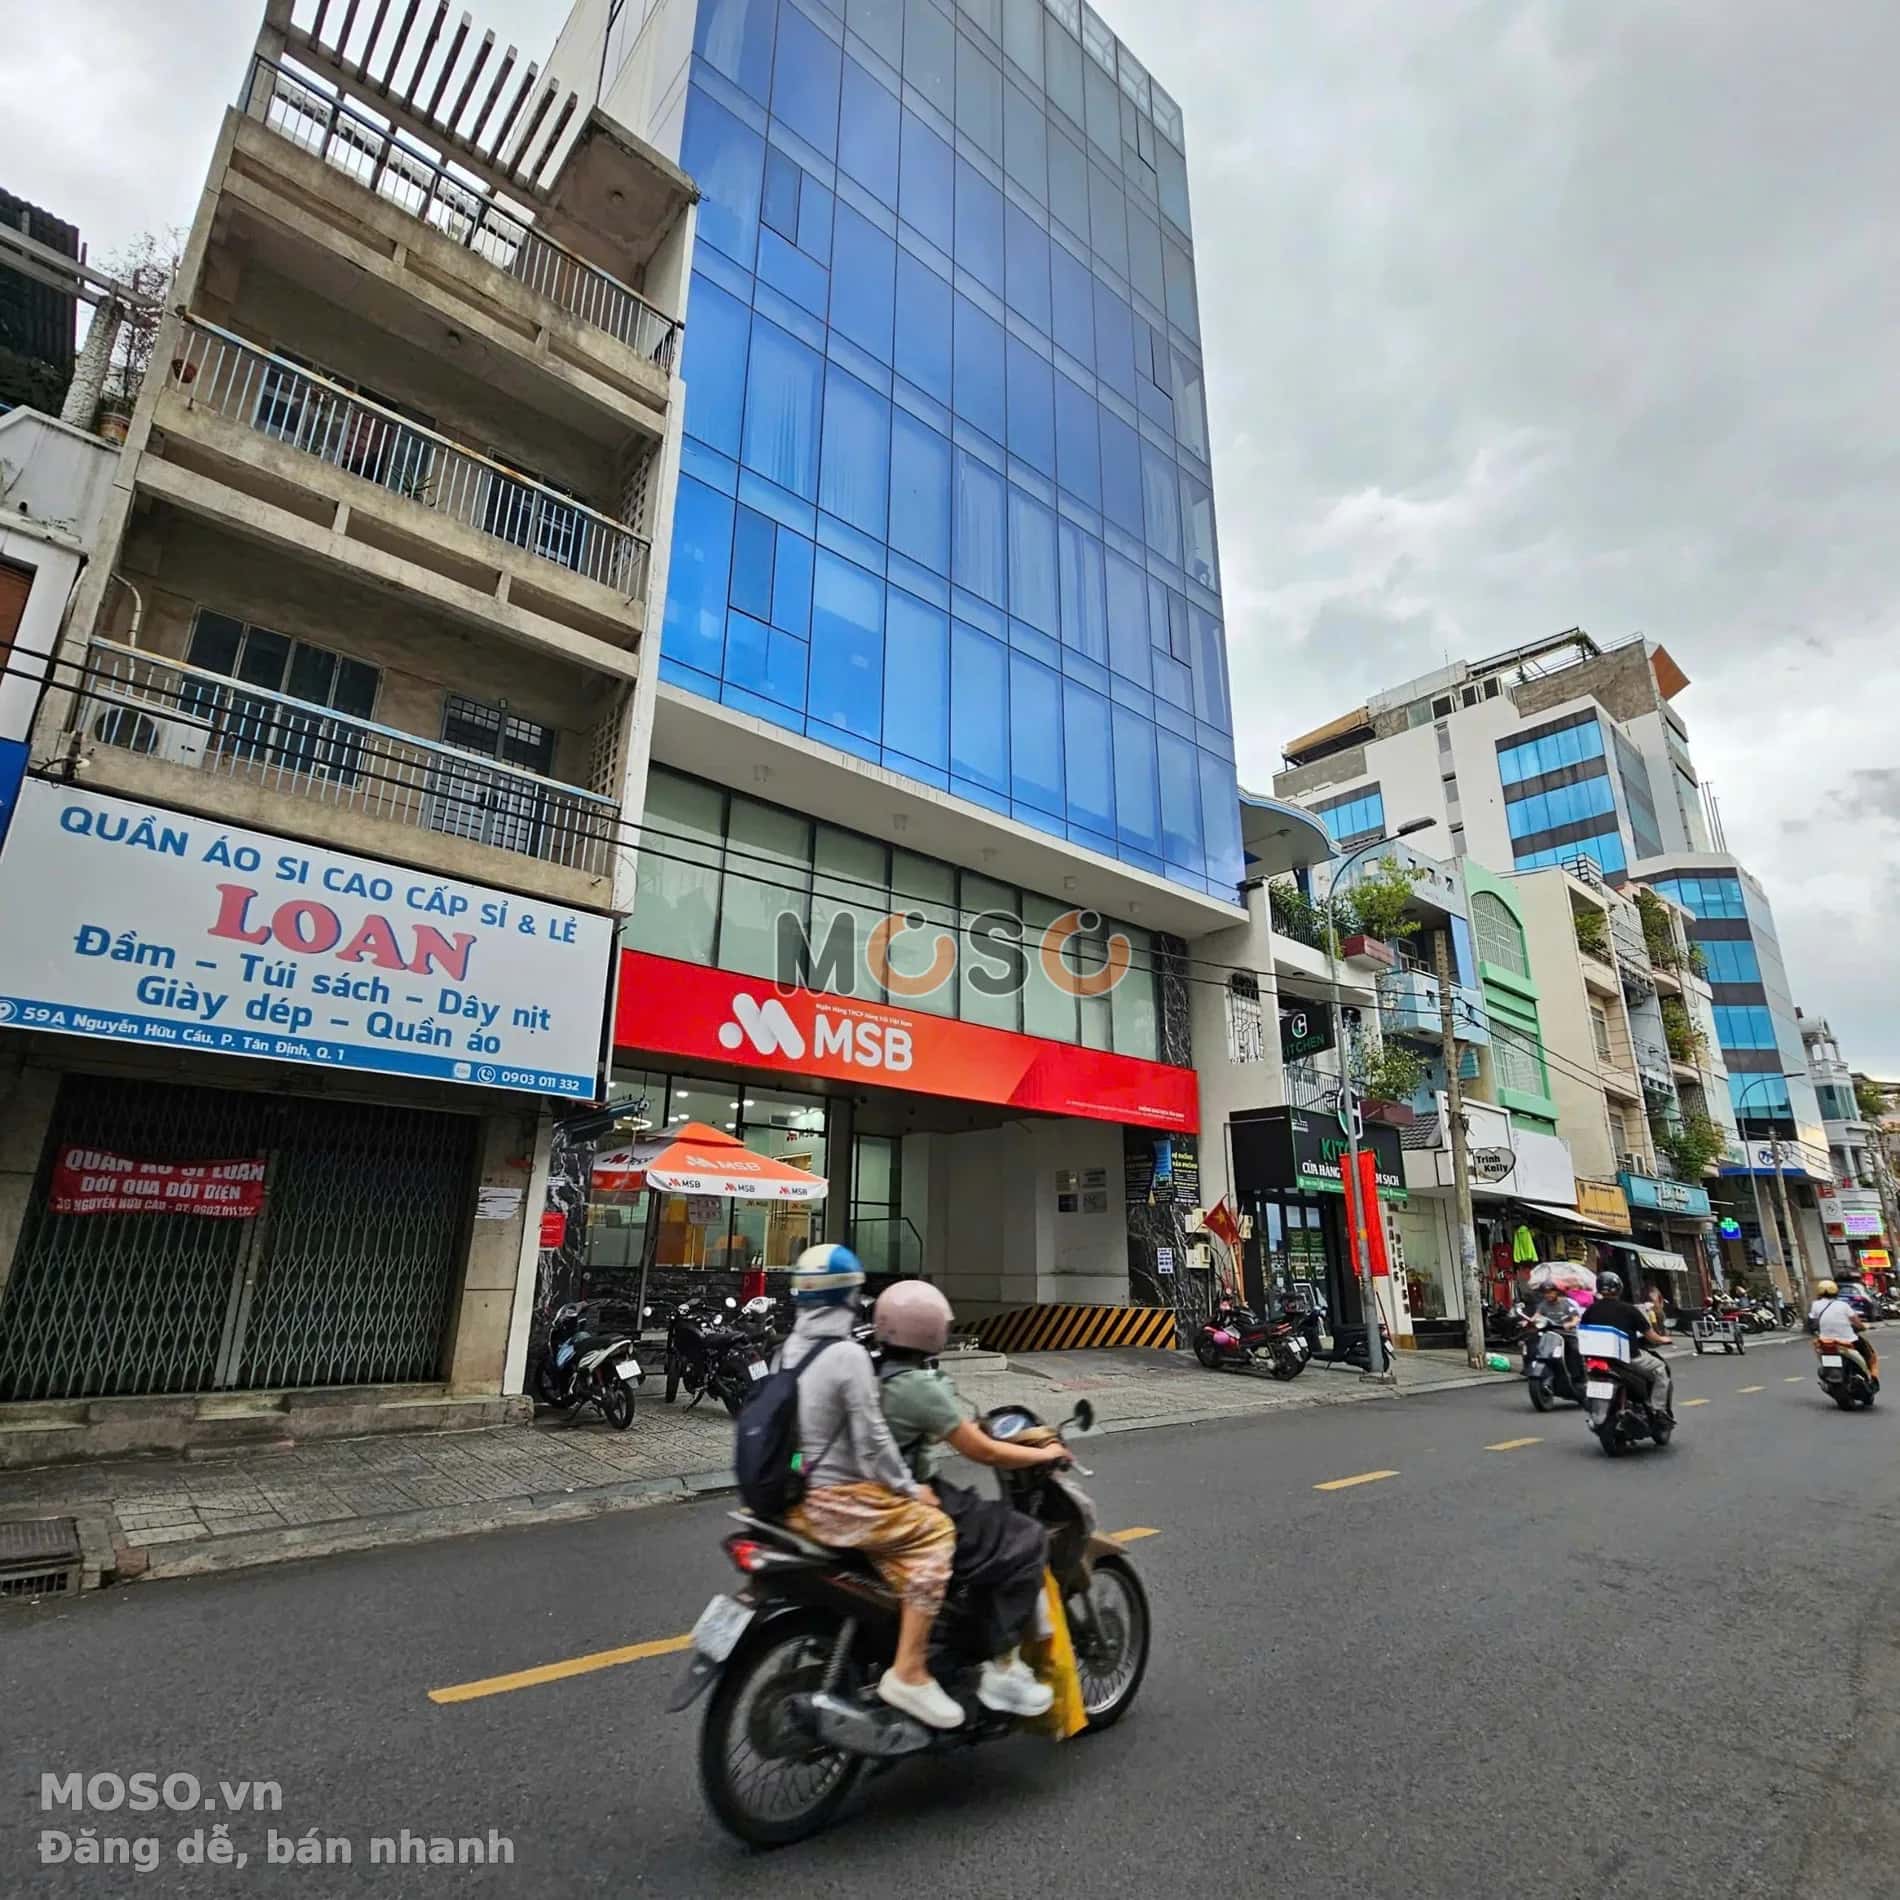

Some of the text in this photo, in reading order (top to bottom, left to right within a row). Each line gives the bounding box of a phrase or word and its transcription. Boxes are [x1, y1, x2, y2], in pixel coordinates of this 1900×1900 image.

[60, 806, 578, 944] QUẦN ÁO SI CAO CẤP SỈ & LẺ
[208, 883, 477, 982] LOAN
[73, 924, 176, 969] Đầm
[239, 952, 297, 989] Túi
[311, 972, 390, 1004] sách
[438, 988, 501, 1027] Dây
[512, 1005, 551, 1034] nịt
[22, 1007, 66, 1026] 59A
[243, 1036, 269, 1052] Tân
[336, 1048, 345, 1061] 1
[136, 975, 229, 1021] Giày
[245, 993, 313, 1034] dép
[366, 1011, 452, 1047] Quần
[466, 1028, 501, 1054] áo
[814, 1013, 913, 1072] MSB
[501, 1071, 580, 1091] 0903 011 332
[682, 1179, 701, 1189] MSB
[716, 1159, 761, 1172] MSB
[738, 1184, 755, 1193] MSB
